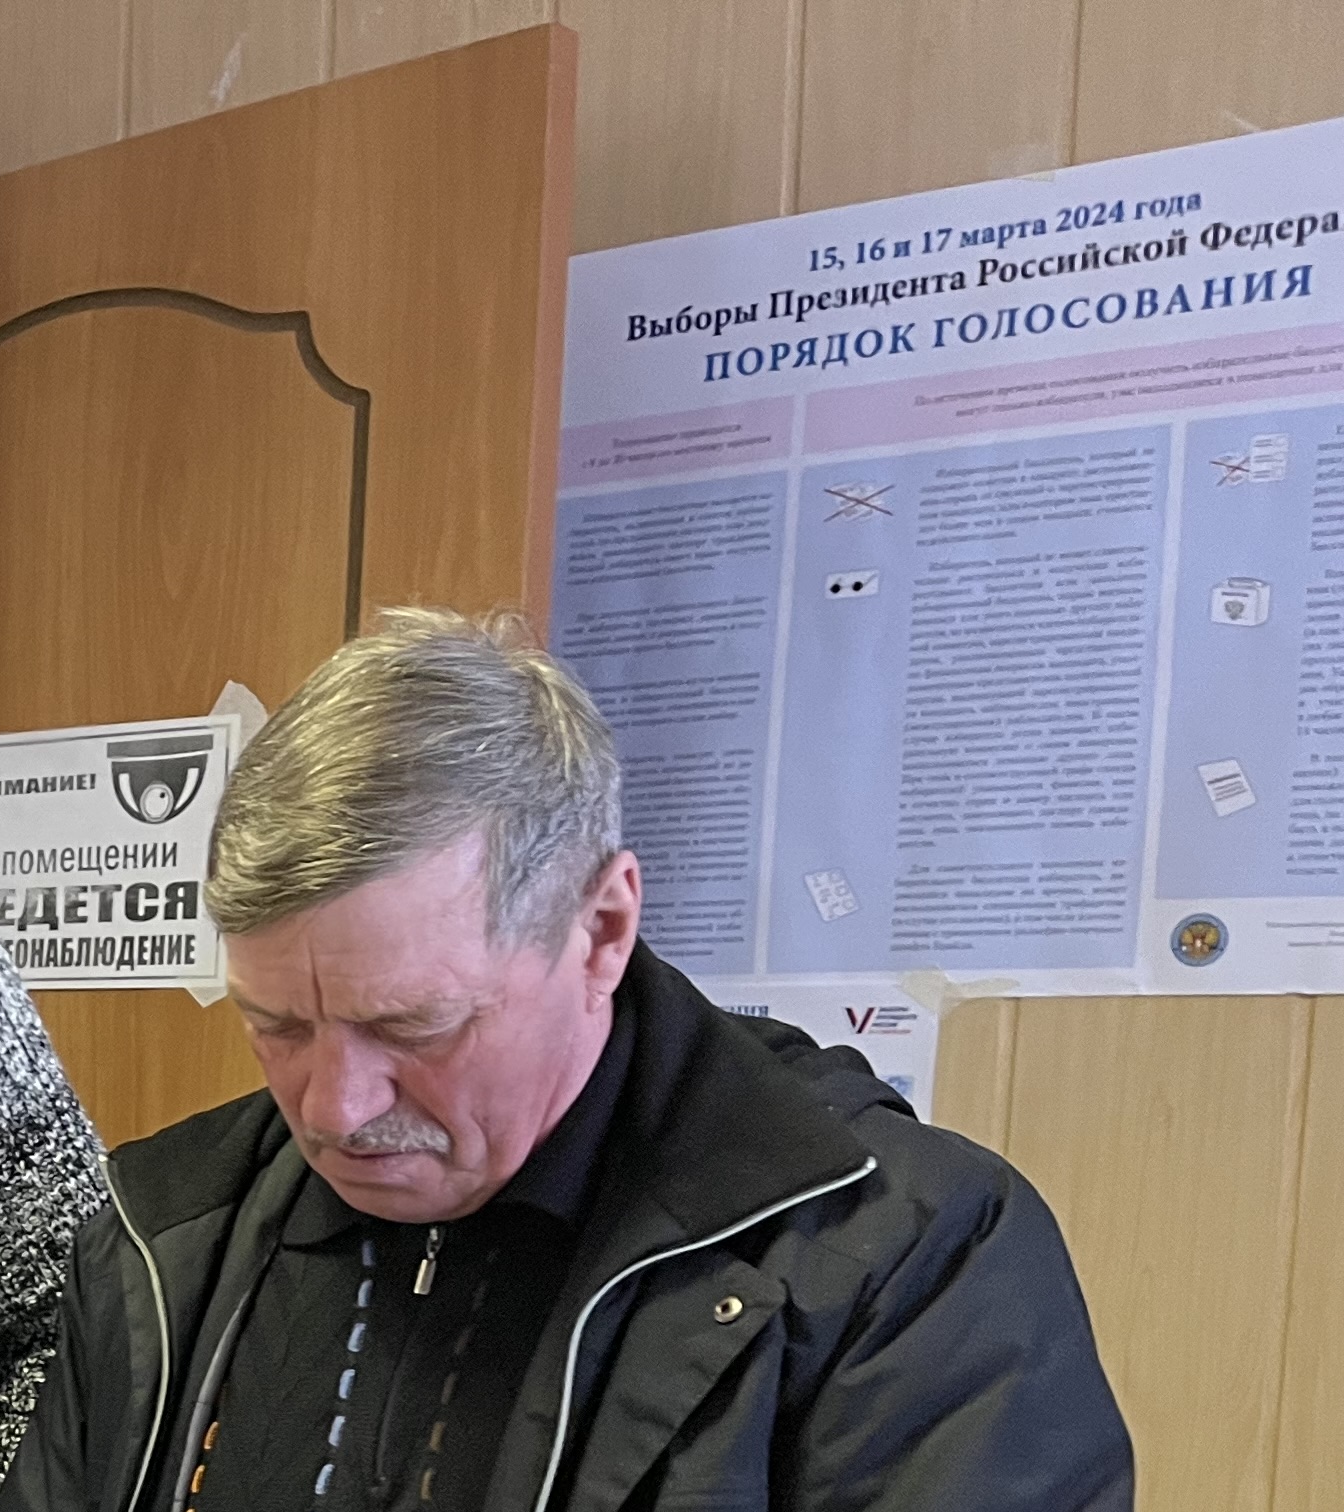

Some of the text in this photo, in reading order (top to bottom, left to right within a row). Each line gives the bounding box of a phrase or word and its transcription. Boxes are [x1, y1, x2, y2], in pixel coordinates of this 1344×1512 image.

[626, 209, 1344, 342] Выборы Президента Российской Федера
[808, 192, 1203, 272] 15, 16 и 17 марта 2024 года
[702, 263, 1314, 382] ПОРЯДОК ГОЛОСОВАНИЯ
